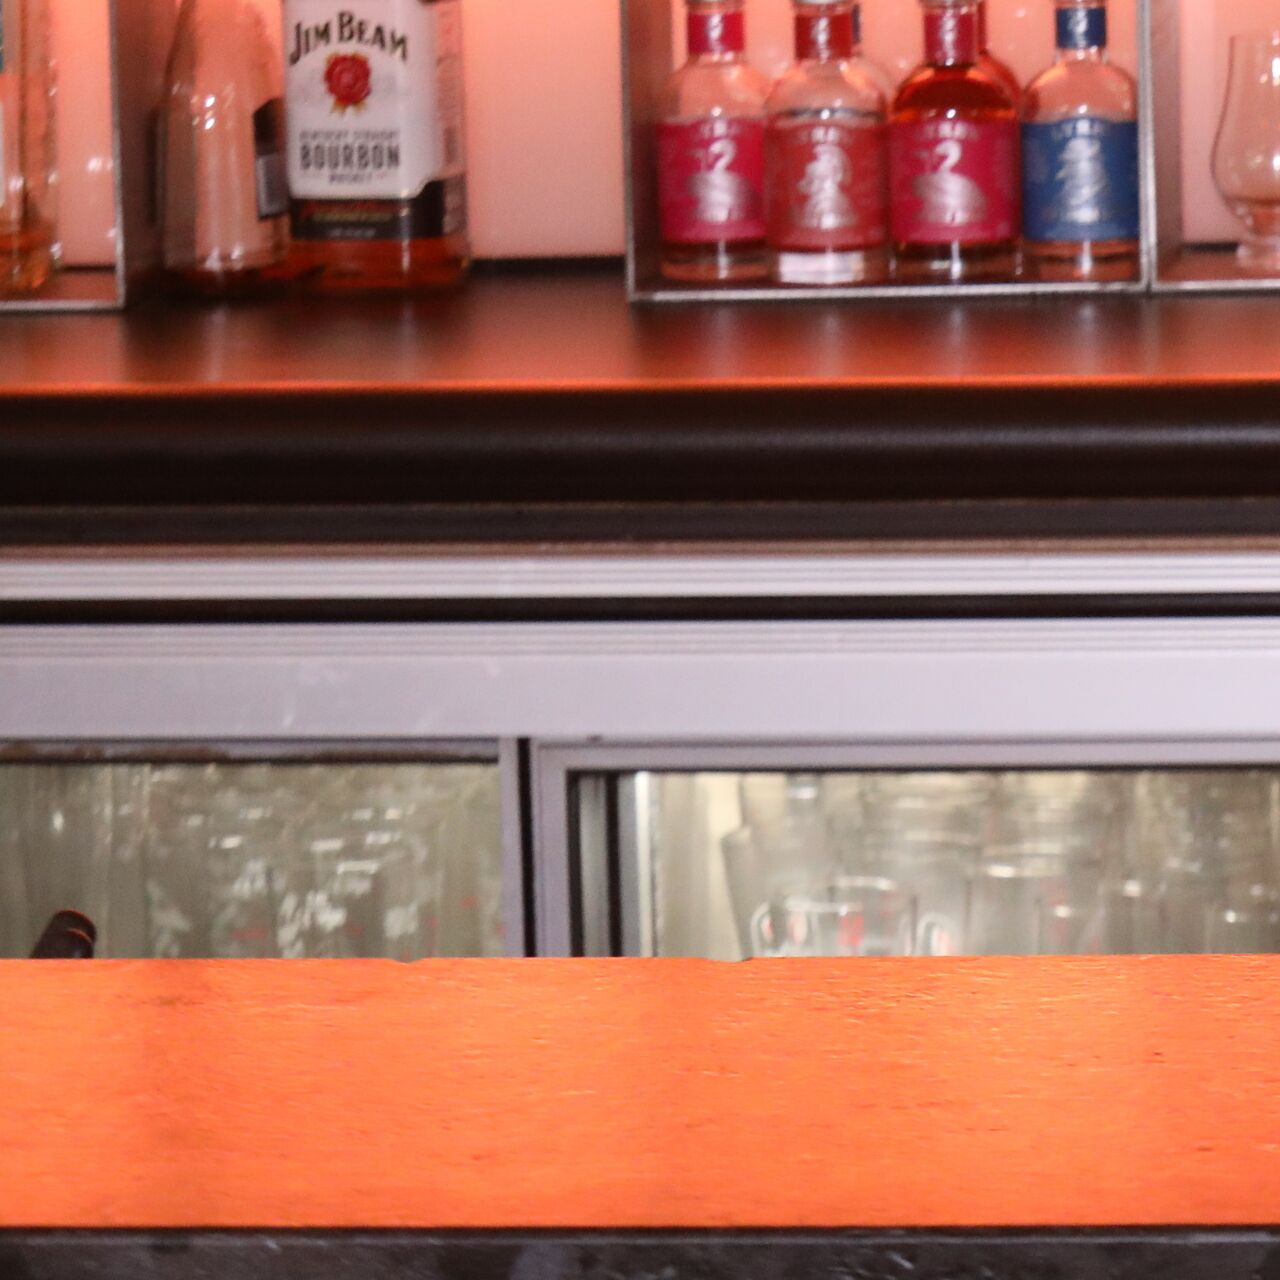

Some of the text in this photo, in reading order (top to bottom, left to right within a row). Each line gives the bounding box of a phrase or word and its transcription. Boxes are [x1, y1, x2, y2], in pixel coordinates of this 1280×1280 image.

[288, 9, 409, 66] JIM BEAM
[301, 142, 399, 169] BOURBON
